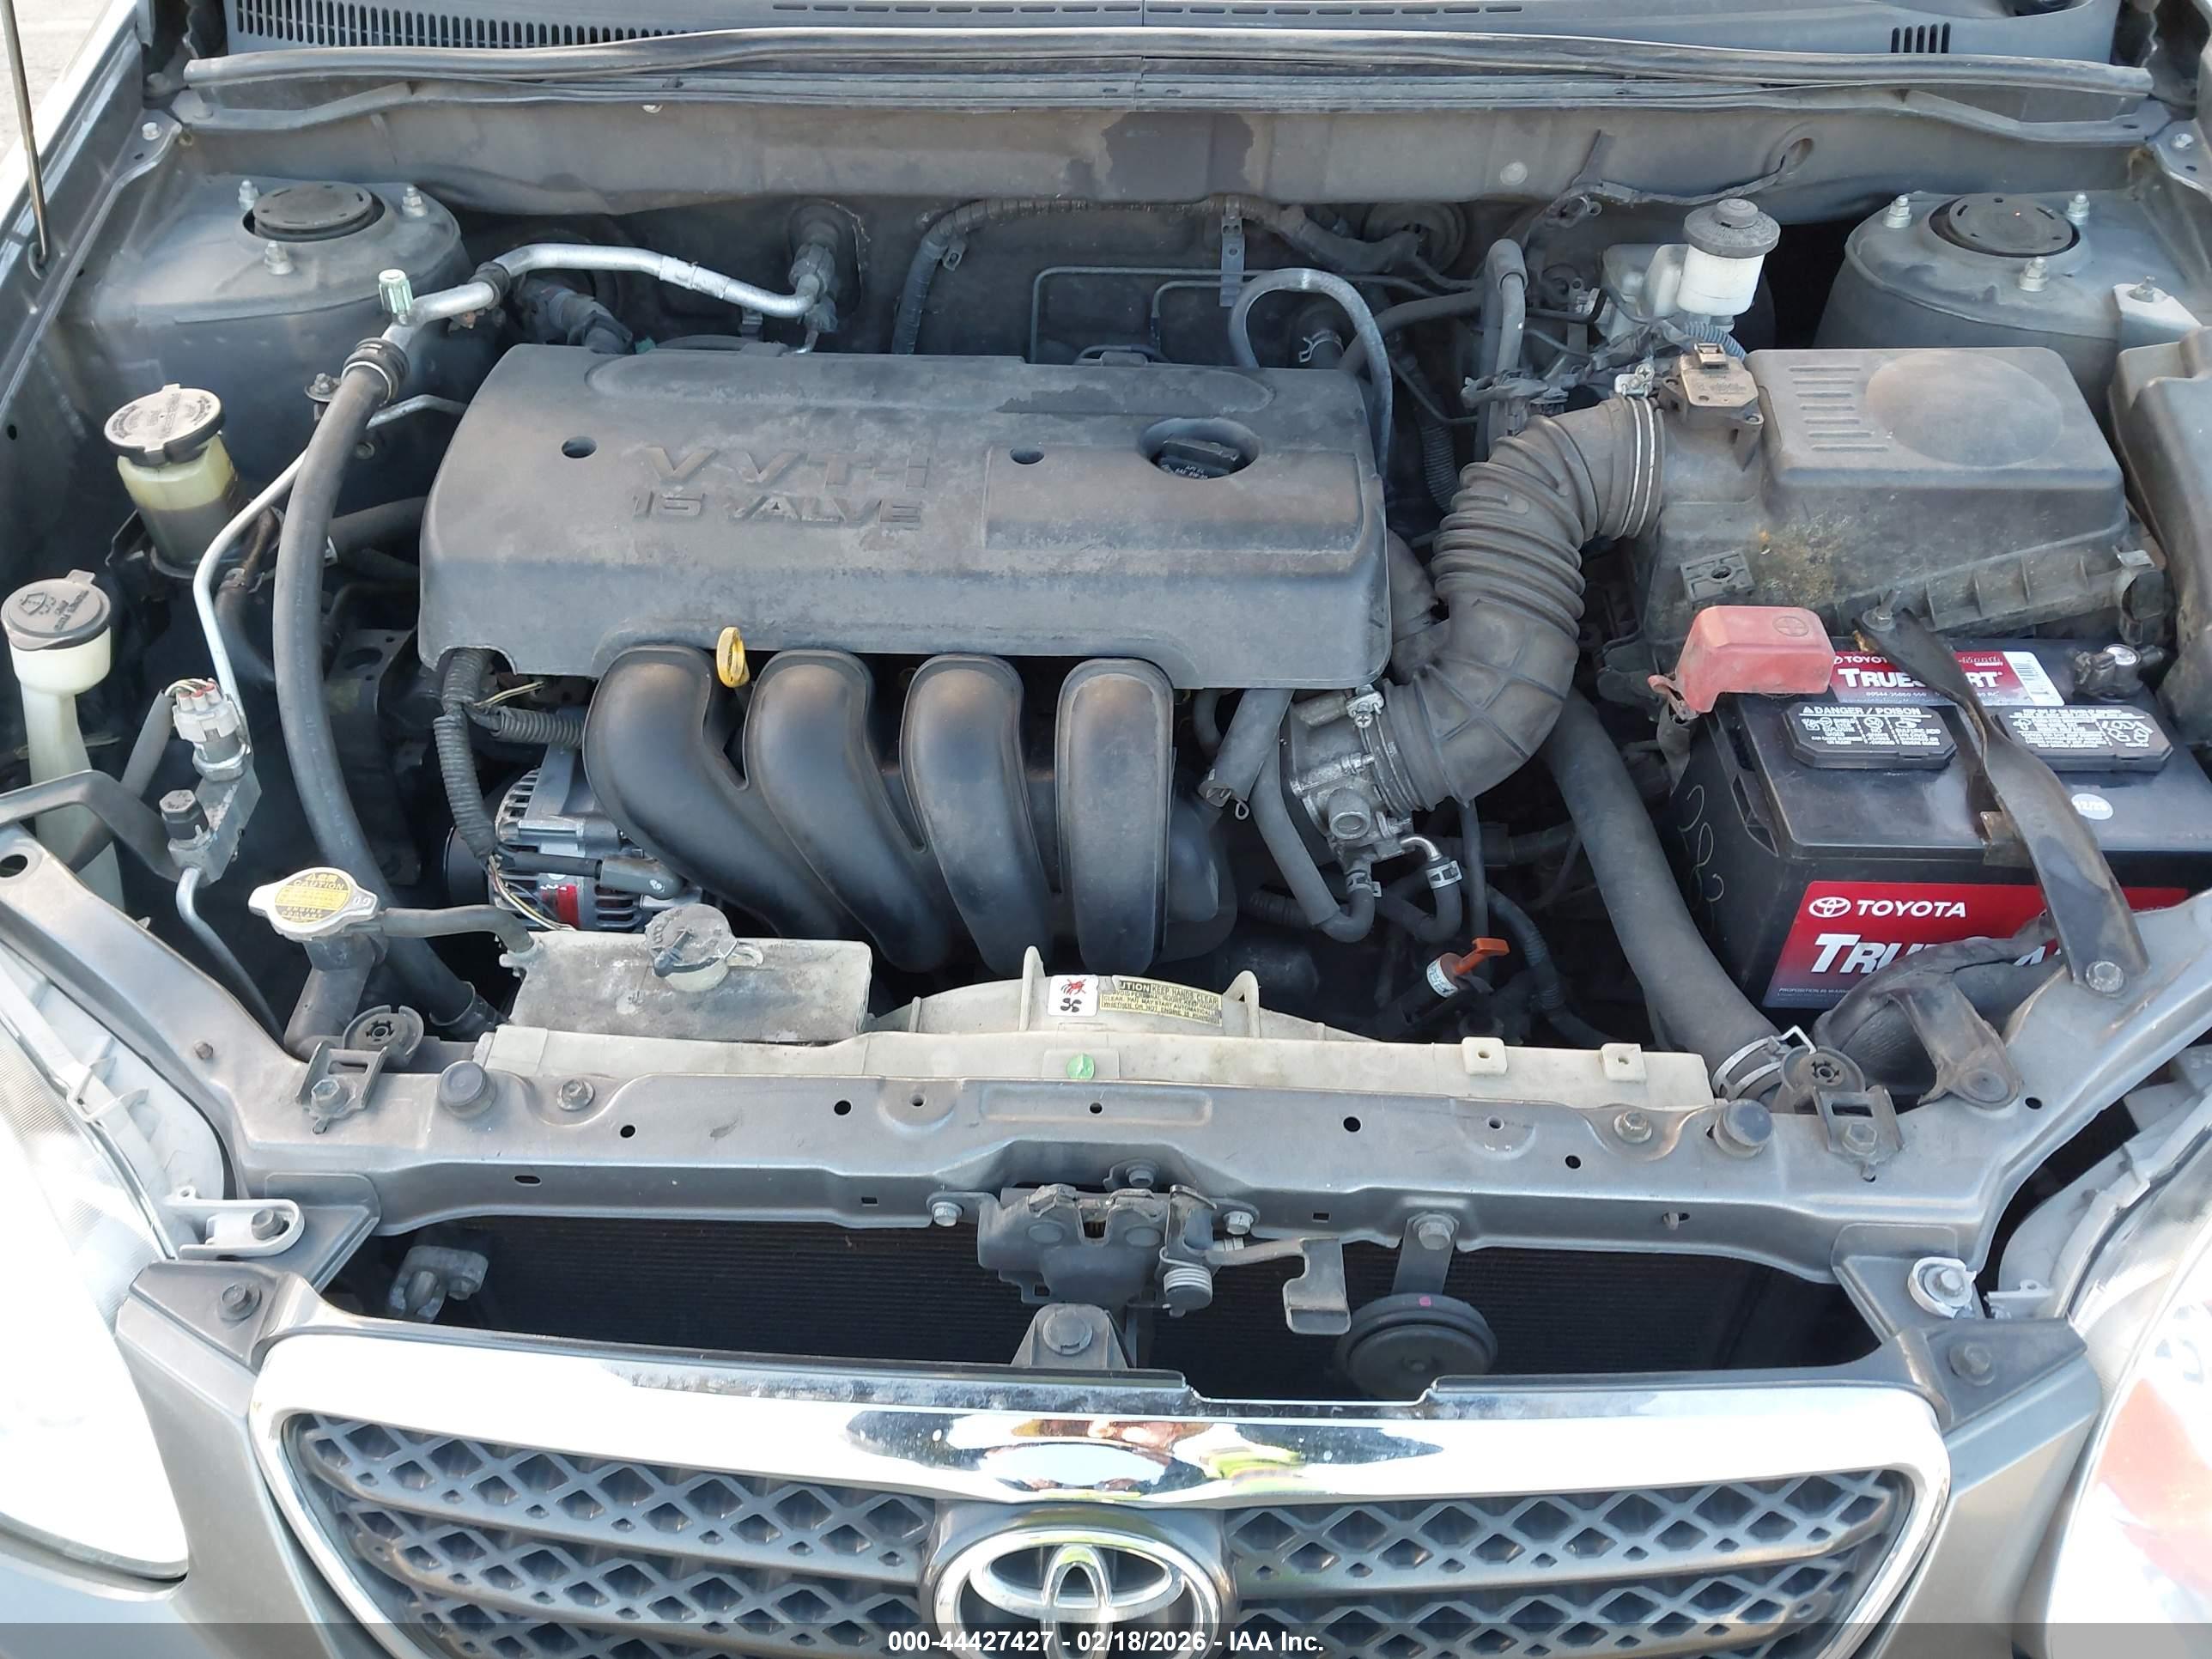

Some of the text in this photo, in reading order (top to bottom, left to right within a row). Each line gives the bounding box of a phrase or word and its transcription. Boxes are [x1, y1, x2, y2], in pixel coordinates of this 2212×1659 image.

[728, 495, 923, 531] VALVE
[1844, 655, 1888, 664] TOYOT
[1814, 706, 1864, 714] DANGER
[1875, 707, 1922, 715] POISON
[293, 879, 344, 890] CAUTION
[1856, 899, 1967, 919] TOYOTA
[1119, 981, 1218, 1004] UTION KEEP HANDS CLEAR
